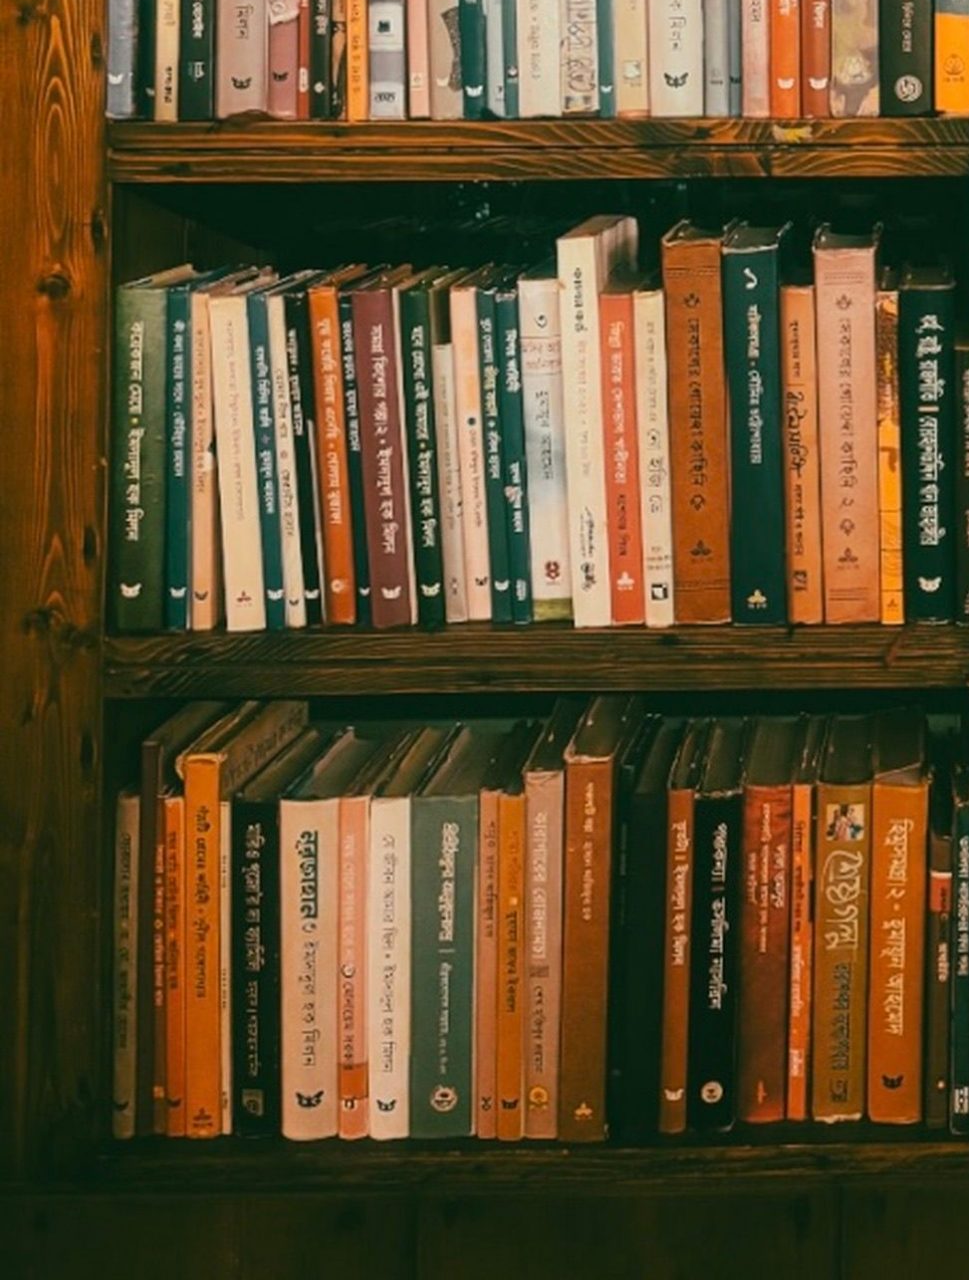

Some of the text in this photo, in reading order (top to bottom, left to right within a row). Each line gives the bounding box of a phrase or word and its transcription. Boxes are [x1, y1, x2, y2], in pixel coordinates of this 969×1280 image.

[236, 5, 254, 39] মিলন
[127, 484, 142, 506] হক
[378, 501, 391, 520] হক
[125, 509, 145, 541] মিলন
[380, 523, 396, 553] মিলন
[296, 831, 320, 918] নূরজাহান
[883, 974, 906, 1036] আহমেদ
